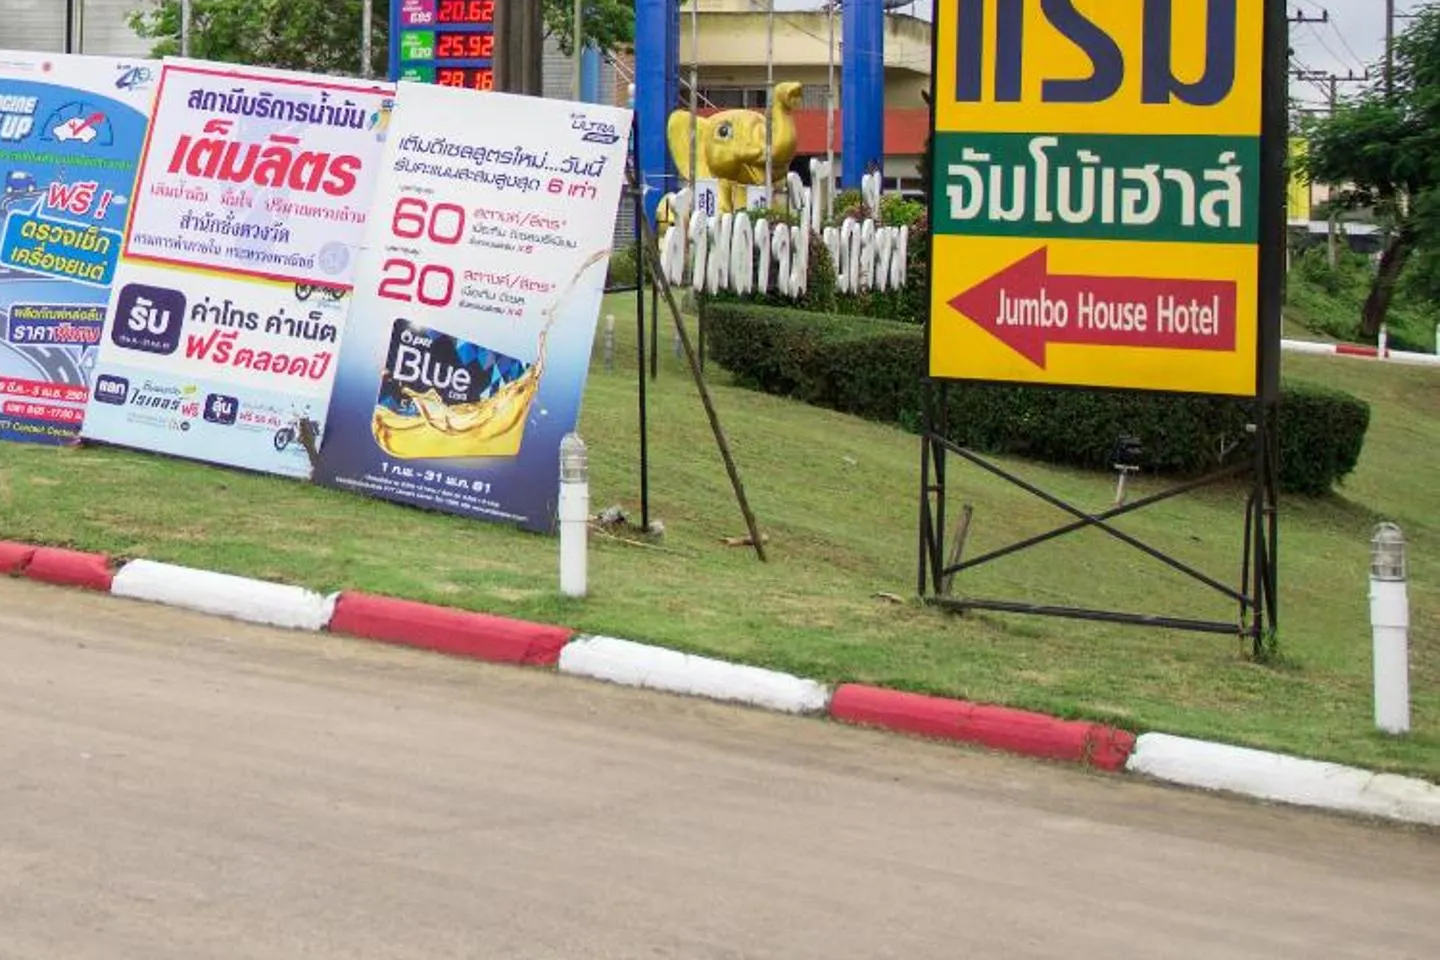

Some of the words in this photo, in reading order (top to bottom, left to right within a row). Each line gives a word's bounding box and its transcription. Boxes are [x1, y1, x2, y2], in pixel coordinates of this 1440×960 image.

[1, 112, 35, 141] UP
[167, 118, 363, 197] เต็มลิตร
[946, 136, 1242, 227] จัมโบ้เฮาส์
[47, 180, 99, 215] ฟรี
[547, 177, 564, 194] 6
[391, 197, 466, 246] 60
[377, 258, 455, 308] 20
[127, 297, 171, 333] รับ
[190, 297, 259, 330] ค่าโทร
[264, 309, 337, 343] ค่าเน็ต
[995, 287, 1068, 329] Jumbo
[1077, 291, 1147, 331] House
[1157, 294, 1220, 336] Hotel
[393, 343, 471, 392] Blue
